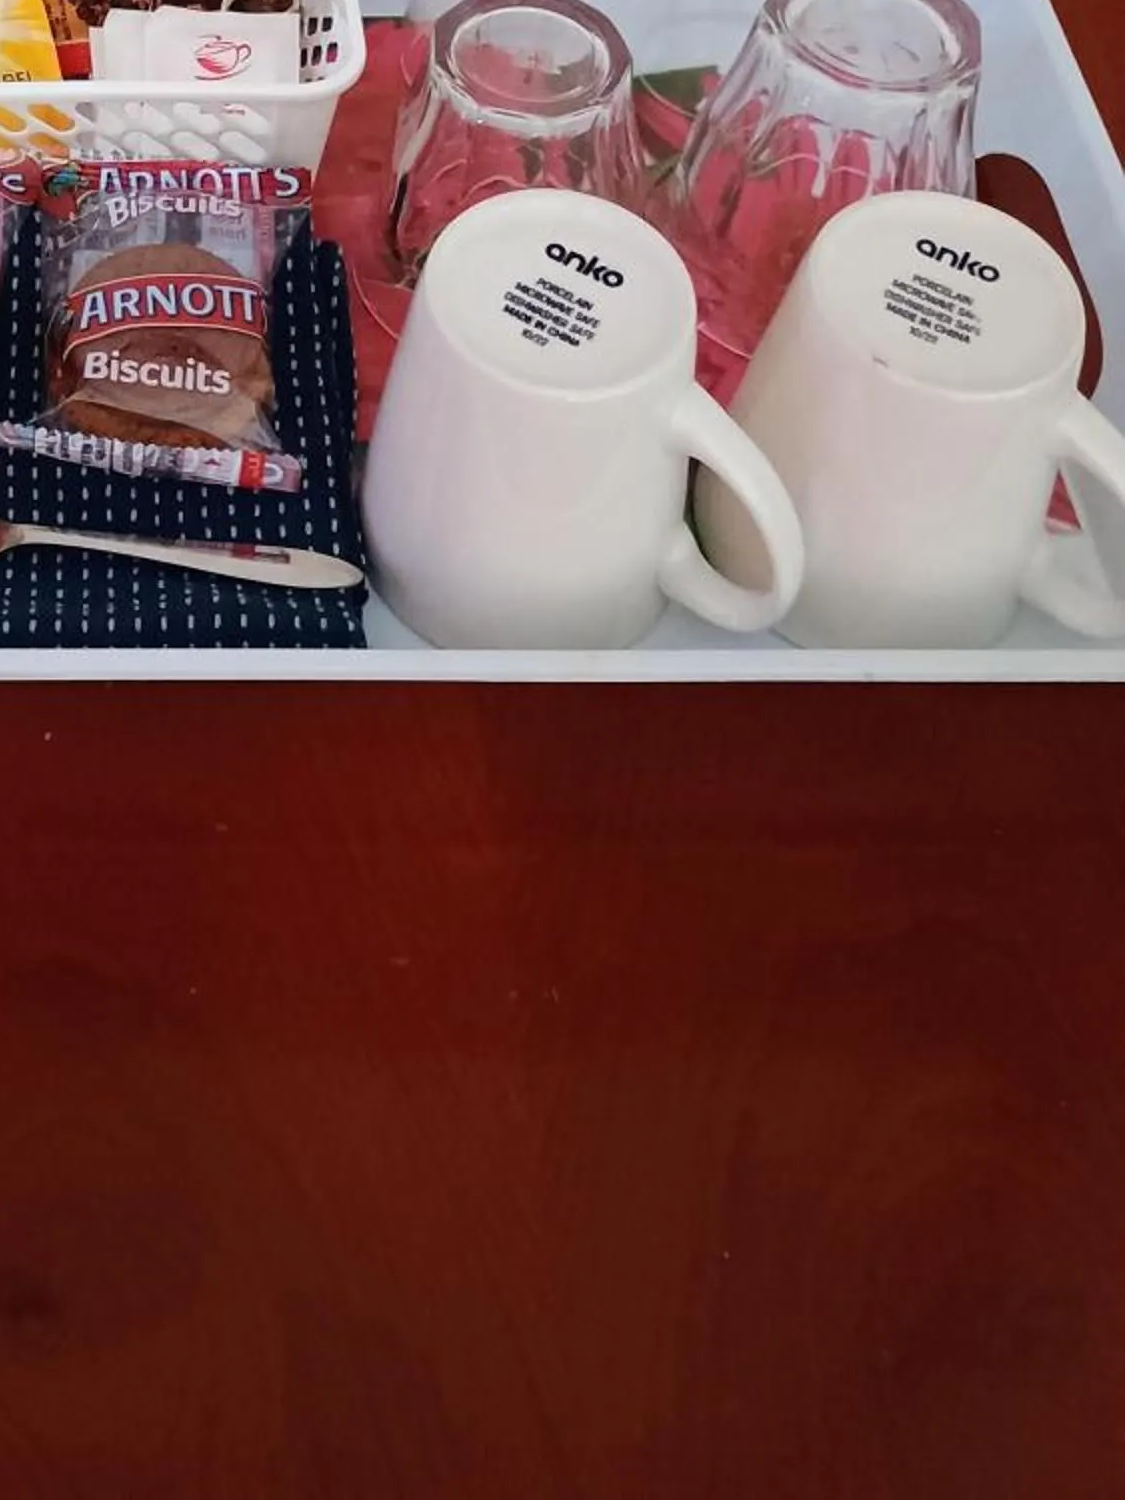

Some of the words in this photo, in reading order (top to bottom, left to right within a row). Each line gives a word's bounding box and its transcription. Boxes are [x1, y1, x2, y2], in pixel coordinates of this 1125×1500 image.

[105, 191, 243, 228] Biscuits
[544, 242, 625, 288] anko
[914, 238, 1001, 283] anko
[503, 291, 569, 328] DISHWASHER
[514, 281, 576, 317] MICROWAVE
[575, 311, 601, 329] SAFE
[536, 277, 595, 311] PORCELAIN
[883, 288, 954, 325] DISHWASHER
[891, 278, 956, 313] MICROWAVE
[912, 273, 974, 307] PORCELAIN
[502, 303, 533, 325] MADE
[533, 319, 547, 331] IN
[546, 326, 581, 347] CHINA
[885, 301, 918, 323] MADE
[918, 317, 932, 329] IN
[933, 322, 971, 344] CHINA
[84, 350, 232, 395] Biscuits
